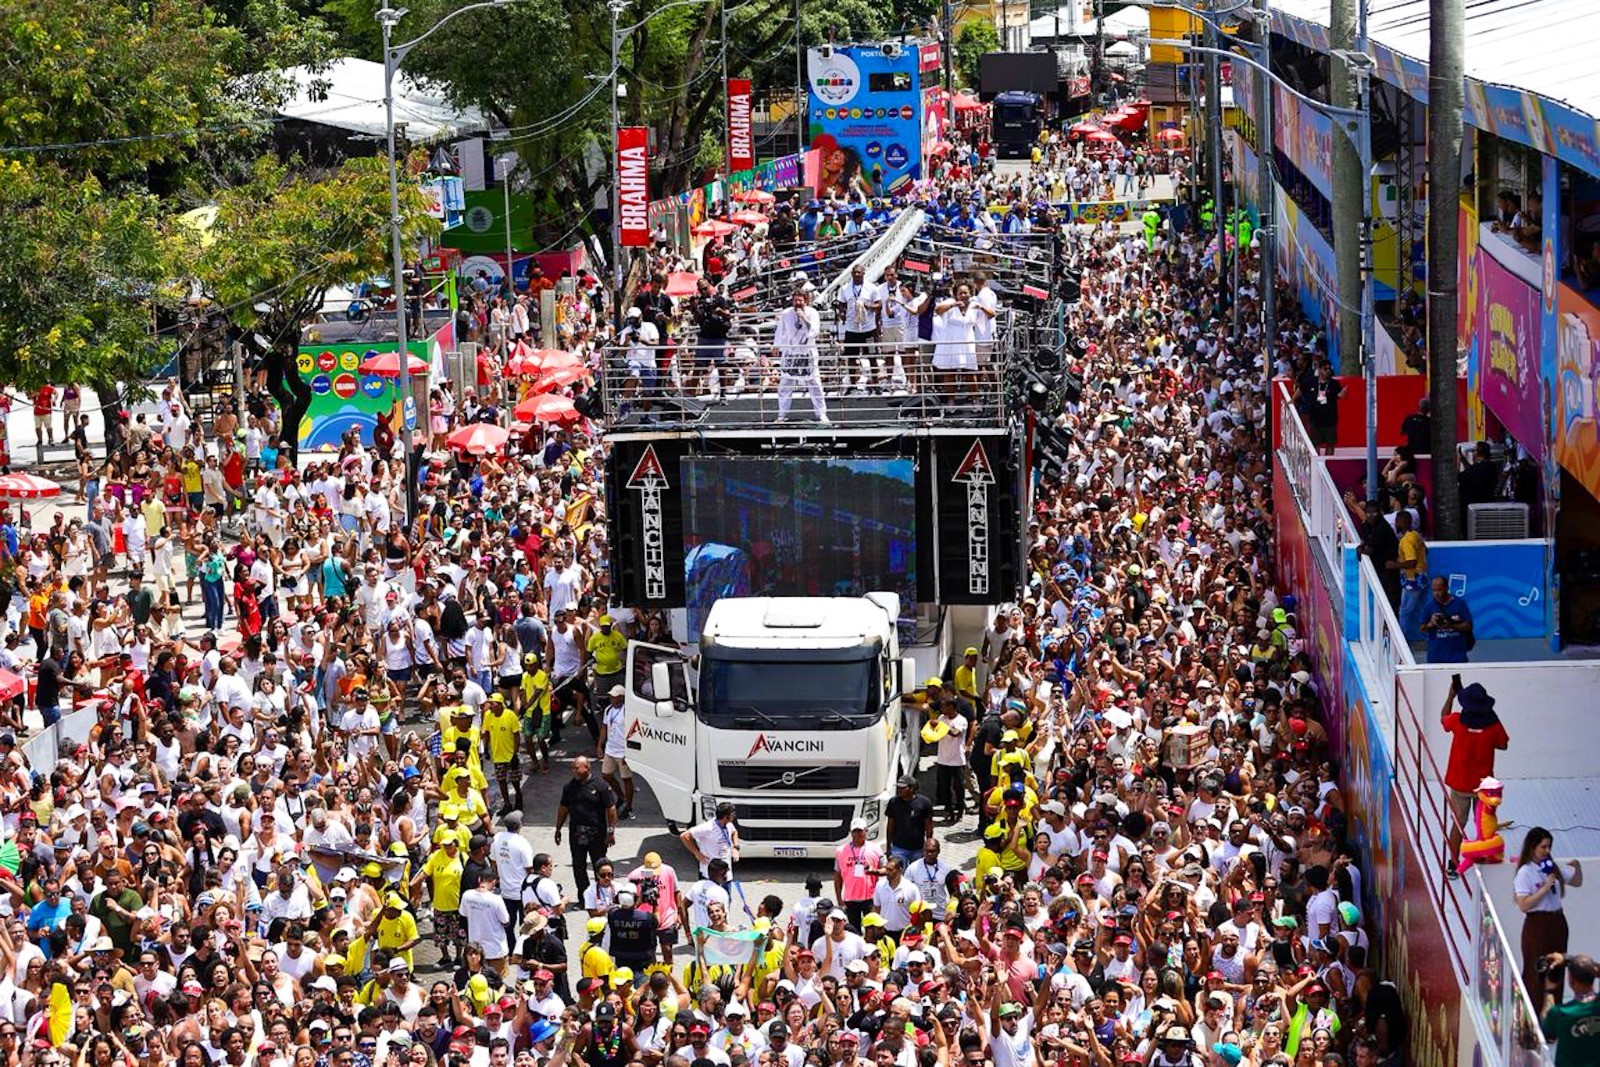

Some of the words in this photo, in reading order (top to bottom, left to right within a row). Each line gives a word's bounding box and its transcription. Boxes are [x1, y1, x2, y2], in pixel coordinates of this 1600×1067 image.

[730, 94, 751, 159] BRAHMA
[620, 146, 647, 230] BRAHMA
[299, 359, 310, 367] 99
[626, 718, 687, 746] AVANCINI
[747, 732, 824, 759] AVANCINI
[614, 920, 643, 928] STAFF
